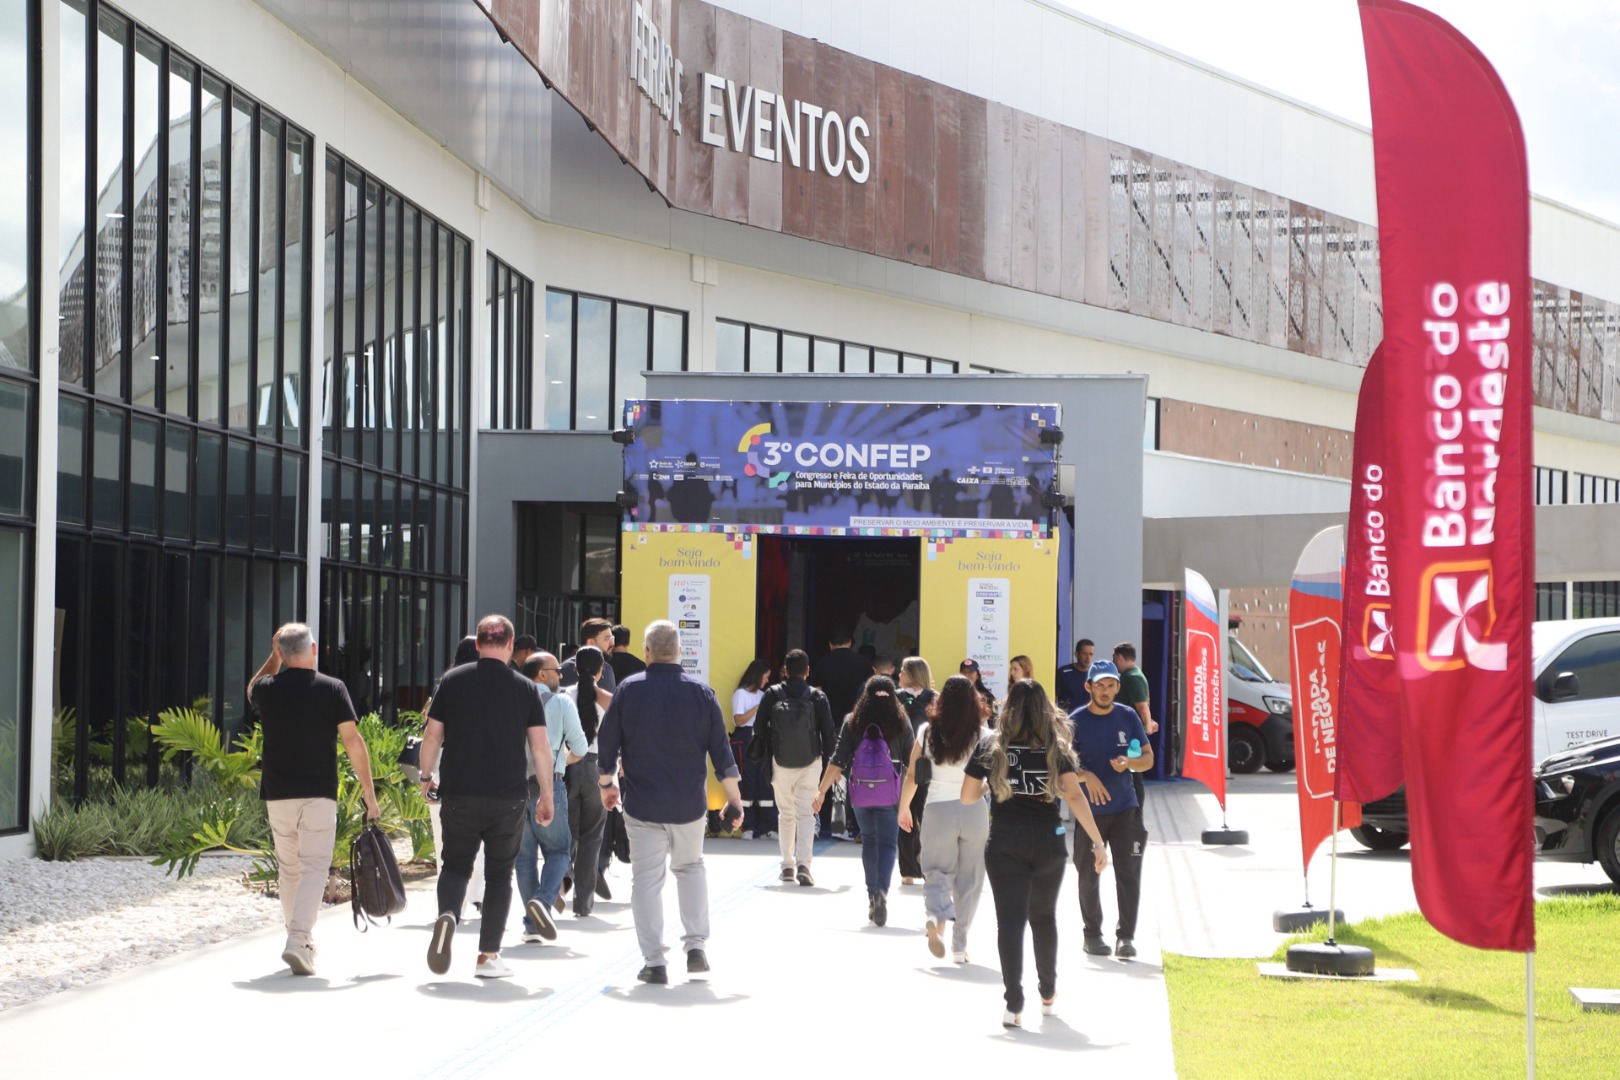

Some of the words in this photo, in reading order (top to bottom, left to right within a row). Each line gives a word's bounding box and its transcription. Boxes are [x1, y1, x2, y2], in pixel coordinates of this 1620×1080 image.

[699, 72, 871, 185] EVENTOS
[1423, 282, 1461, 356] do
[794, 442, 932, 468] CONFEP
[1422, 373, 1467, 548] Banco
[795, 470, 832, 480] Congresso
[840, 472, 856, 480] Feira
[858, 472, 868, 480] de
[869, 472, 923, 482] Oportunidades
[795, 482, 812, 490] para
[1362, 464, 1384, 502] do
[658, 557, 720, 568] bem-vindo
[676, 546, 702, 560] Seja
[976, 551, 1002, 562] Seja
[1364, 510, 1391, 597] Banco
[958, 560, 1020, 572] bem-vindo
[1192, 665, 1203, 725] RODADA
[1210, 669, 1220, 726] CITROËN
[1203, 722, 1210, 742] DE
[1586, 730, 1608, 738] DRIVE
